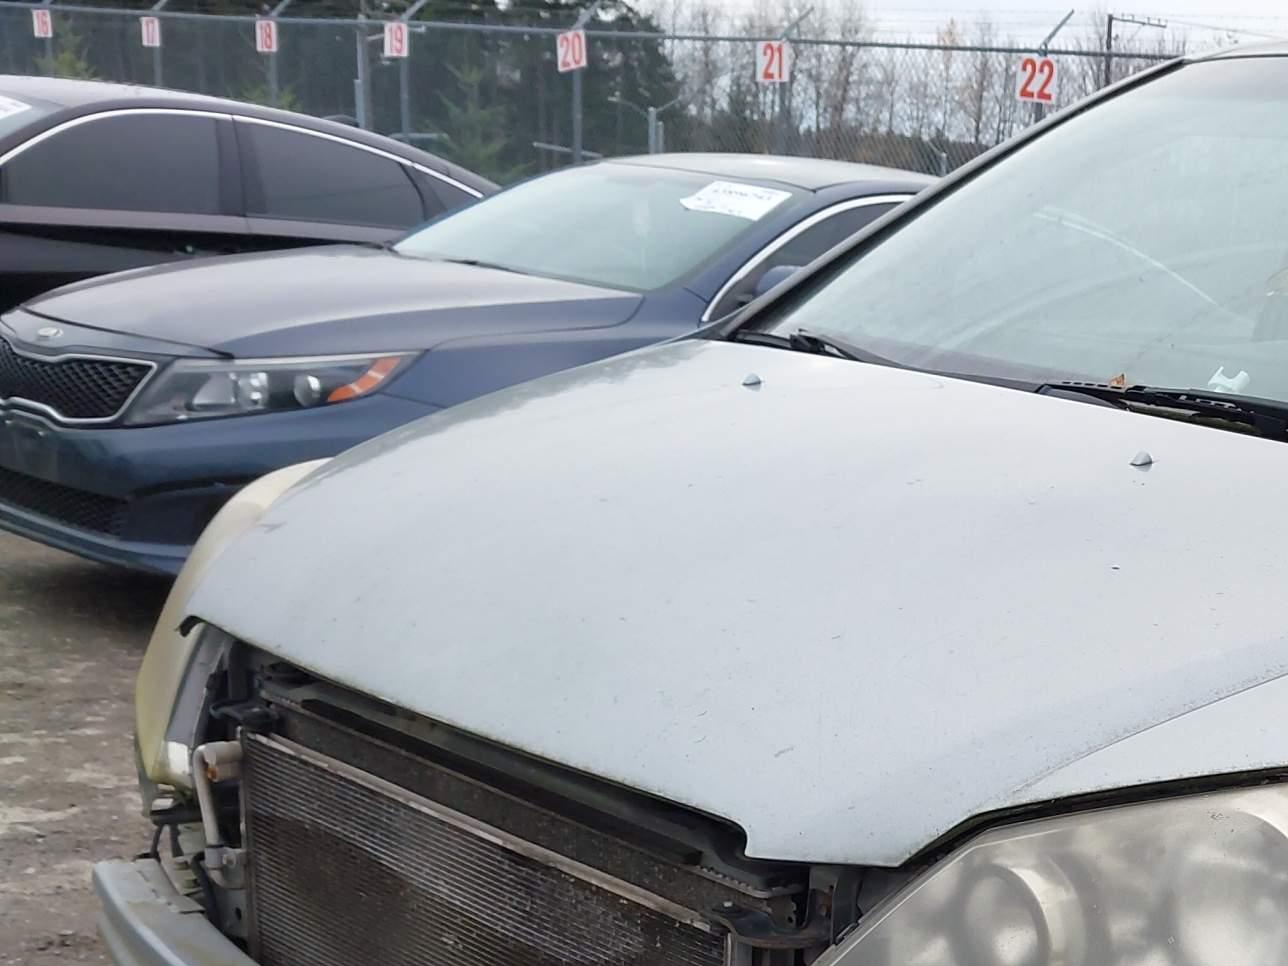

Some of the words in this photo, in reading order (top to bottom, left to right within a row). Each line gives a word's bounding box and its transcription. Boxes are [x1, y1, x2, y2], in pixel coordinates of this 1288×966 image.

[36, 12, 49, 36] 16
[260, 22, 273, 49] 18
[388, 25, 403, 55] 19
[558, 32, 583, 68] 20
[762, 43, 783, 79] 21
[1019, 58, 1055, 101] 22
